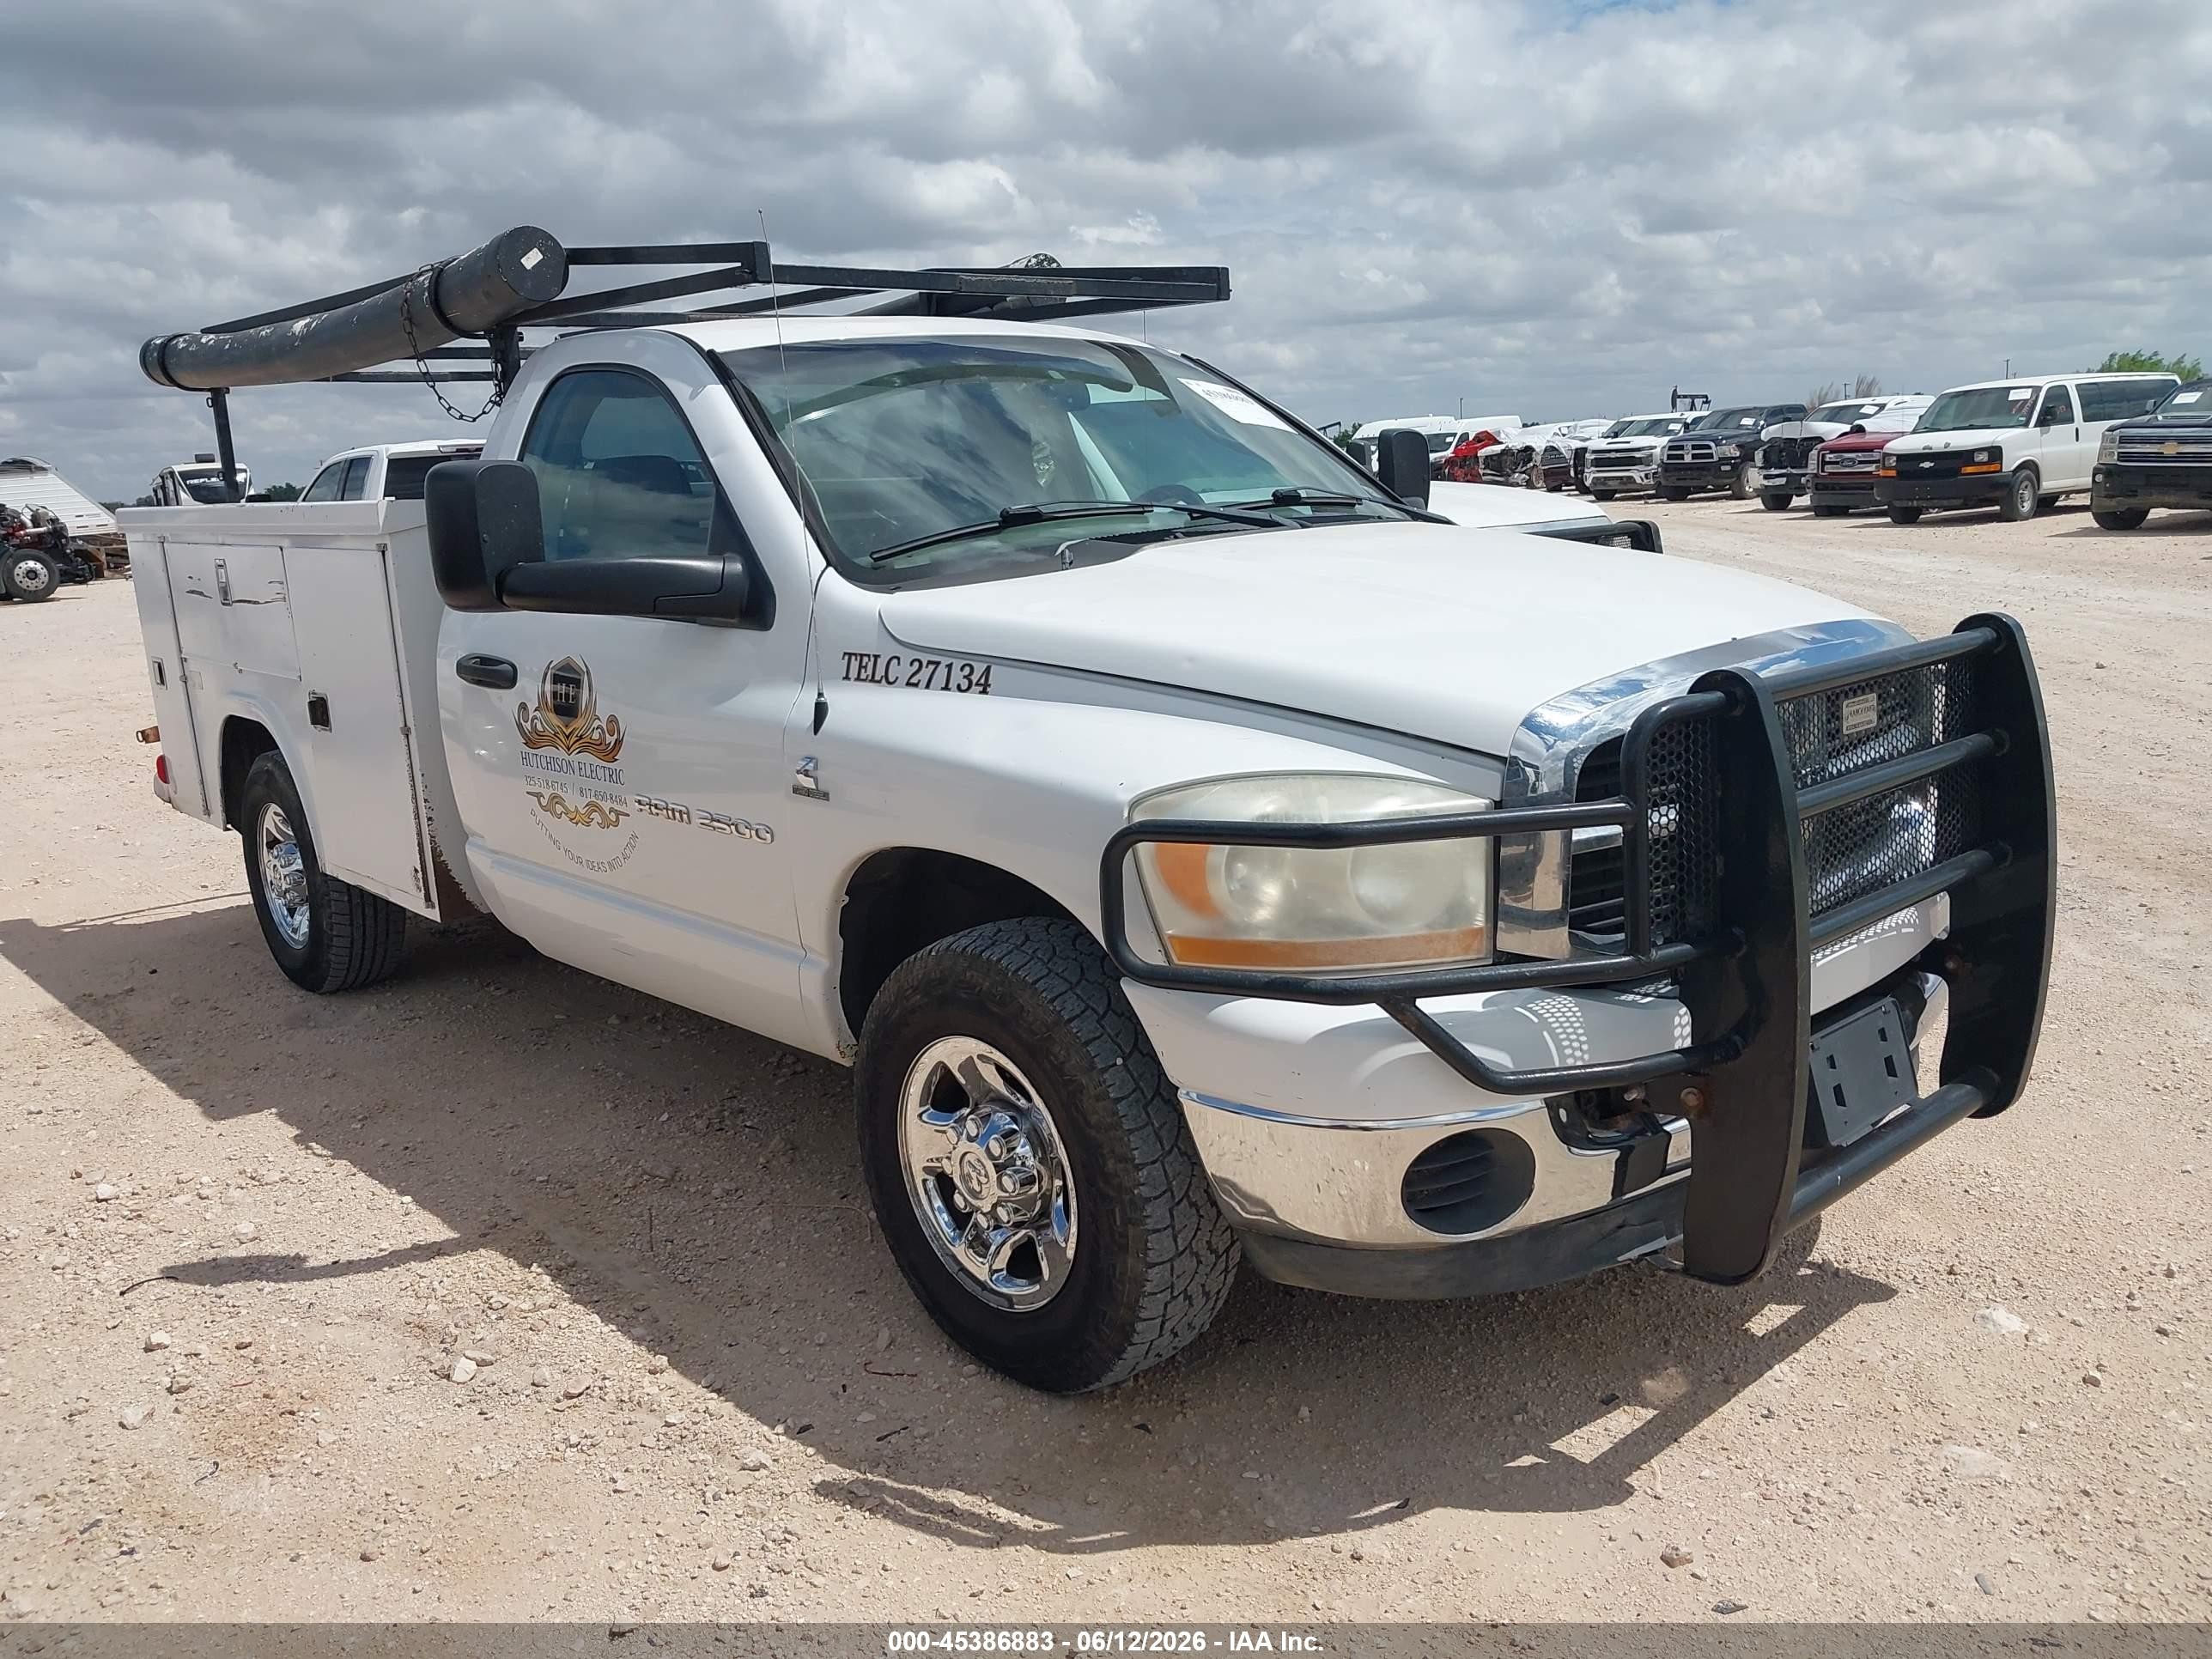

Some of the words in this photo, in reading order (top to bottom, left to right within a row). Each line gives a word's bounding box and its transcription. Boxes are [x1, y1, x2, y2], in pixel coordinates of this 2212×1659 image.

[841, 651, 901, 685] TELC
[904, 657, 992, 693] 27134
[520, 750, 575, 776] HUTCHISON
[577, 761, 625, 786] ELECTRIC
[524, 775, 568, 793] 325-518-6745
[579, 787, 628, 807] 817-650-8484
[634, 793, 691, 825] RAM
[695, 809, 775, 844] 2500
[530, 808, 561, 851] PUTTING
[562, 846, 585, 867] YOUR
[606, 855, 623, 872] INTO
[621, 830, 640, 864] ACTION
